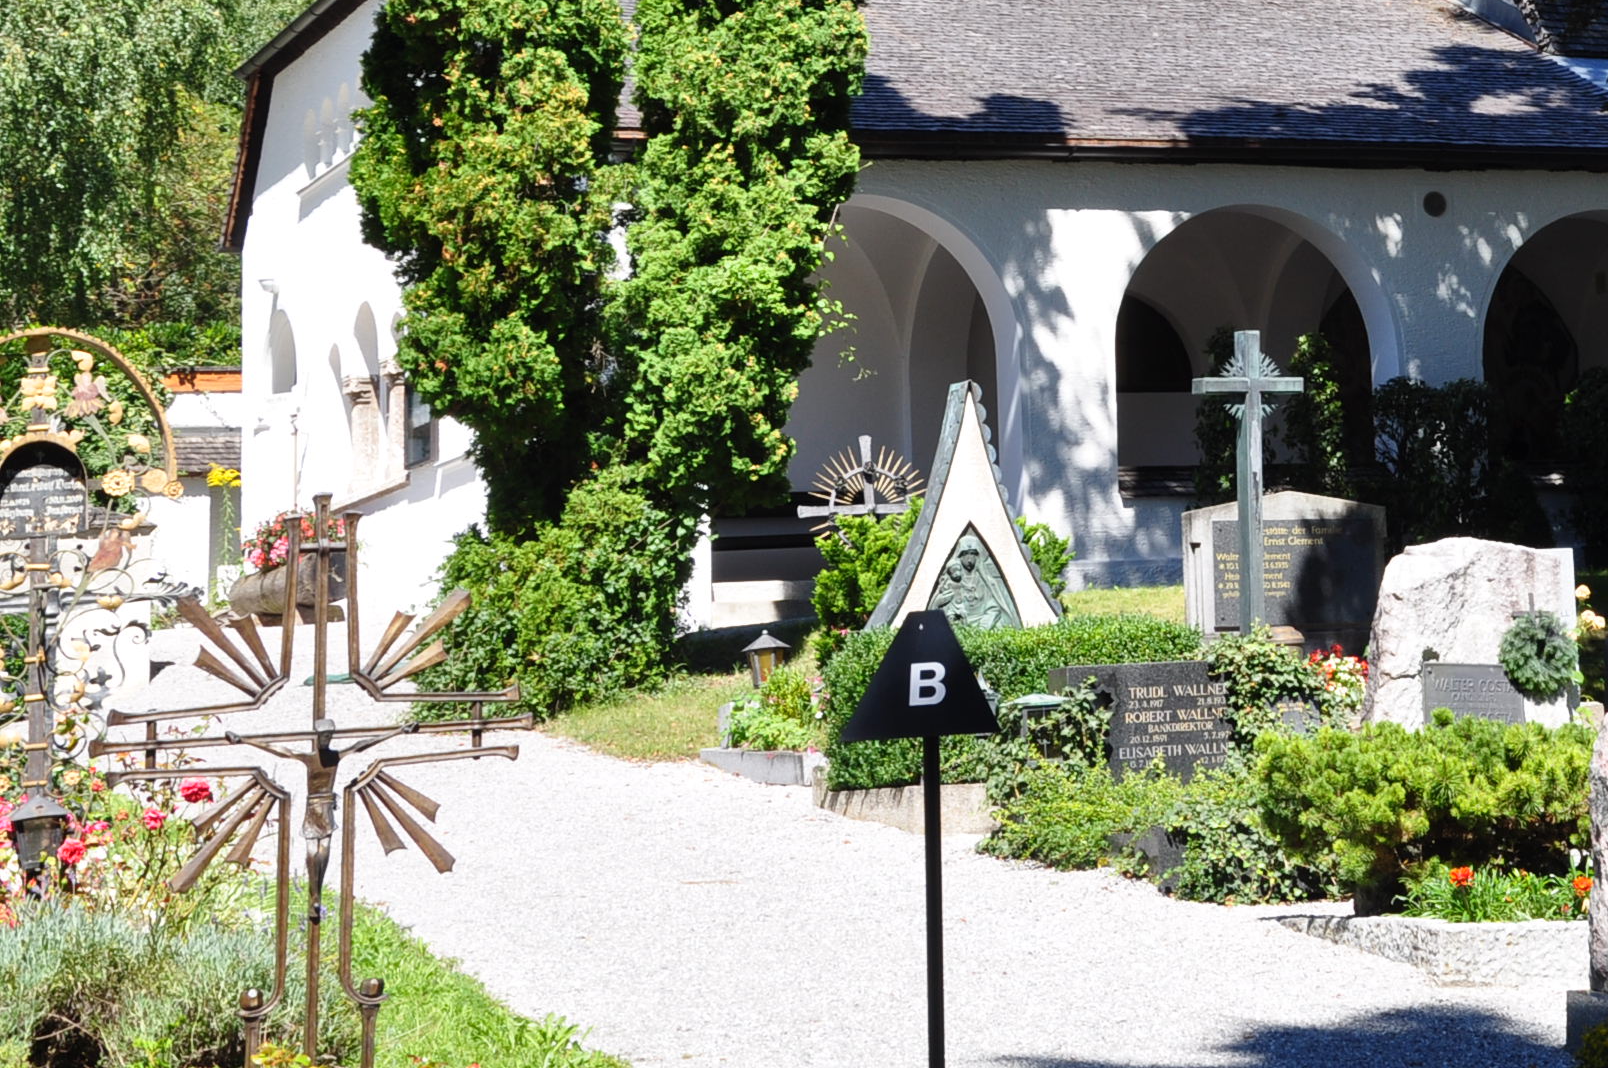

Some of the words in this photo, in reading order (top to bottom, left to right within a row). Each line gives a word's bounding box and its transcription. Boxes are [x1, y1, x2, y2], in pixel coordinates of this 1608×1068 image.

[909, 661, 946, 707] B
[1128, 685, 1168, 699] TRUDL
[1125, 710, 1172, 724] ROBERT
[1148, 720, 1213, 733] BANKDIREKTOR
